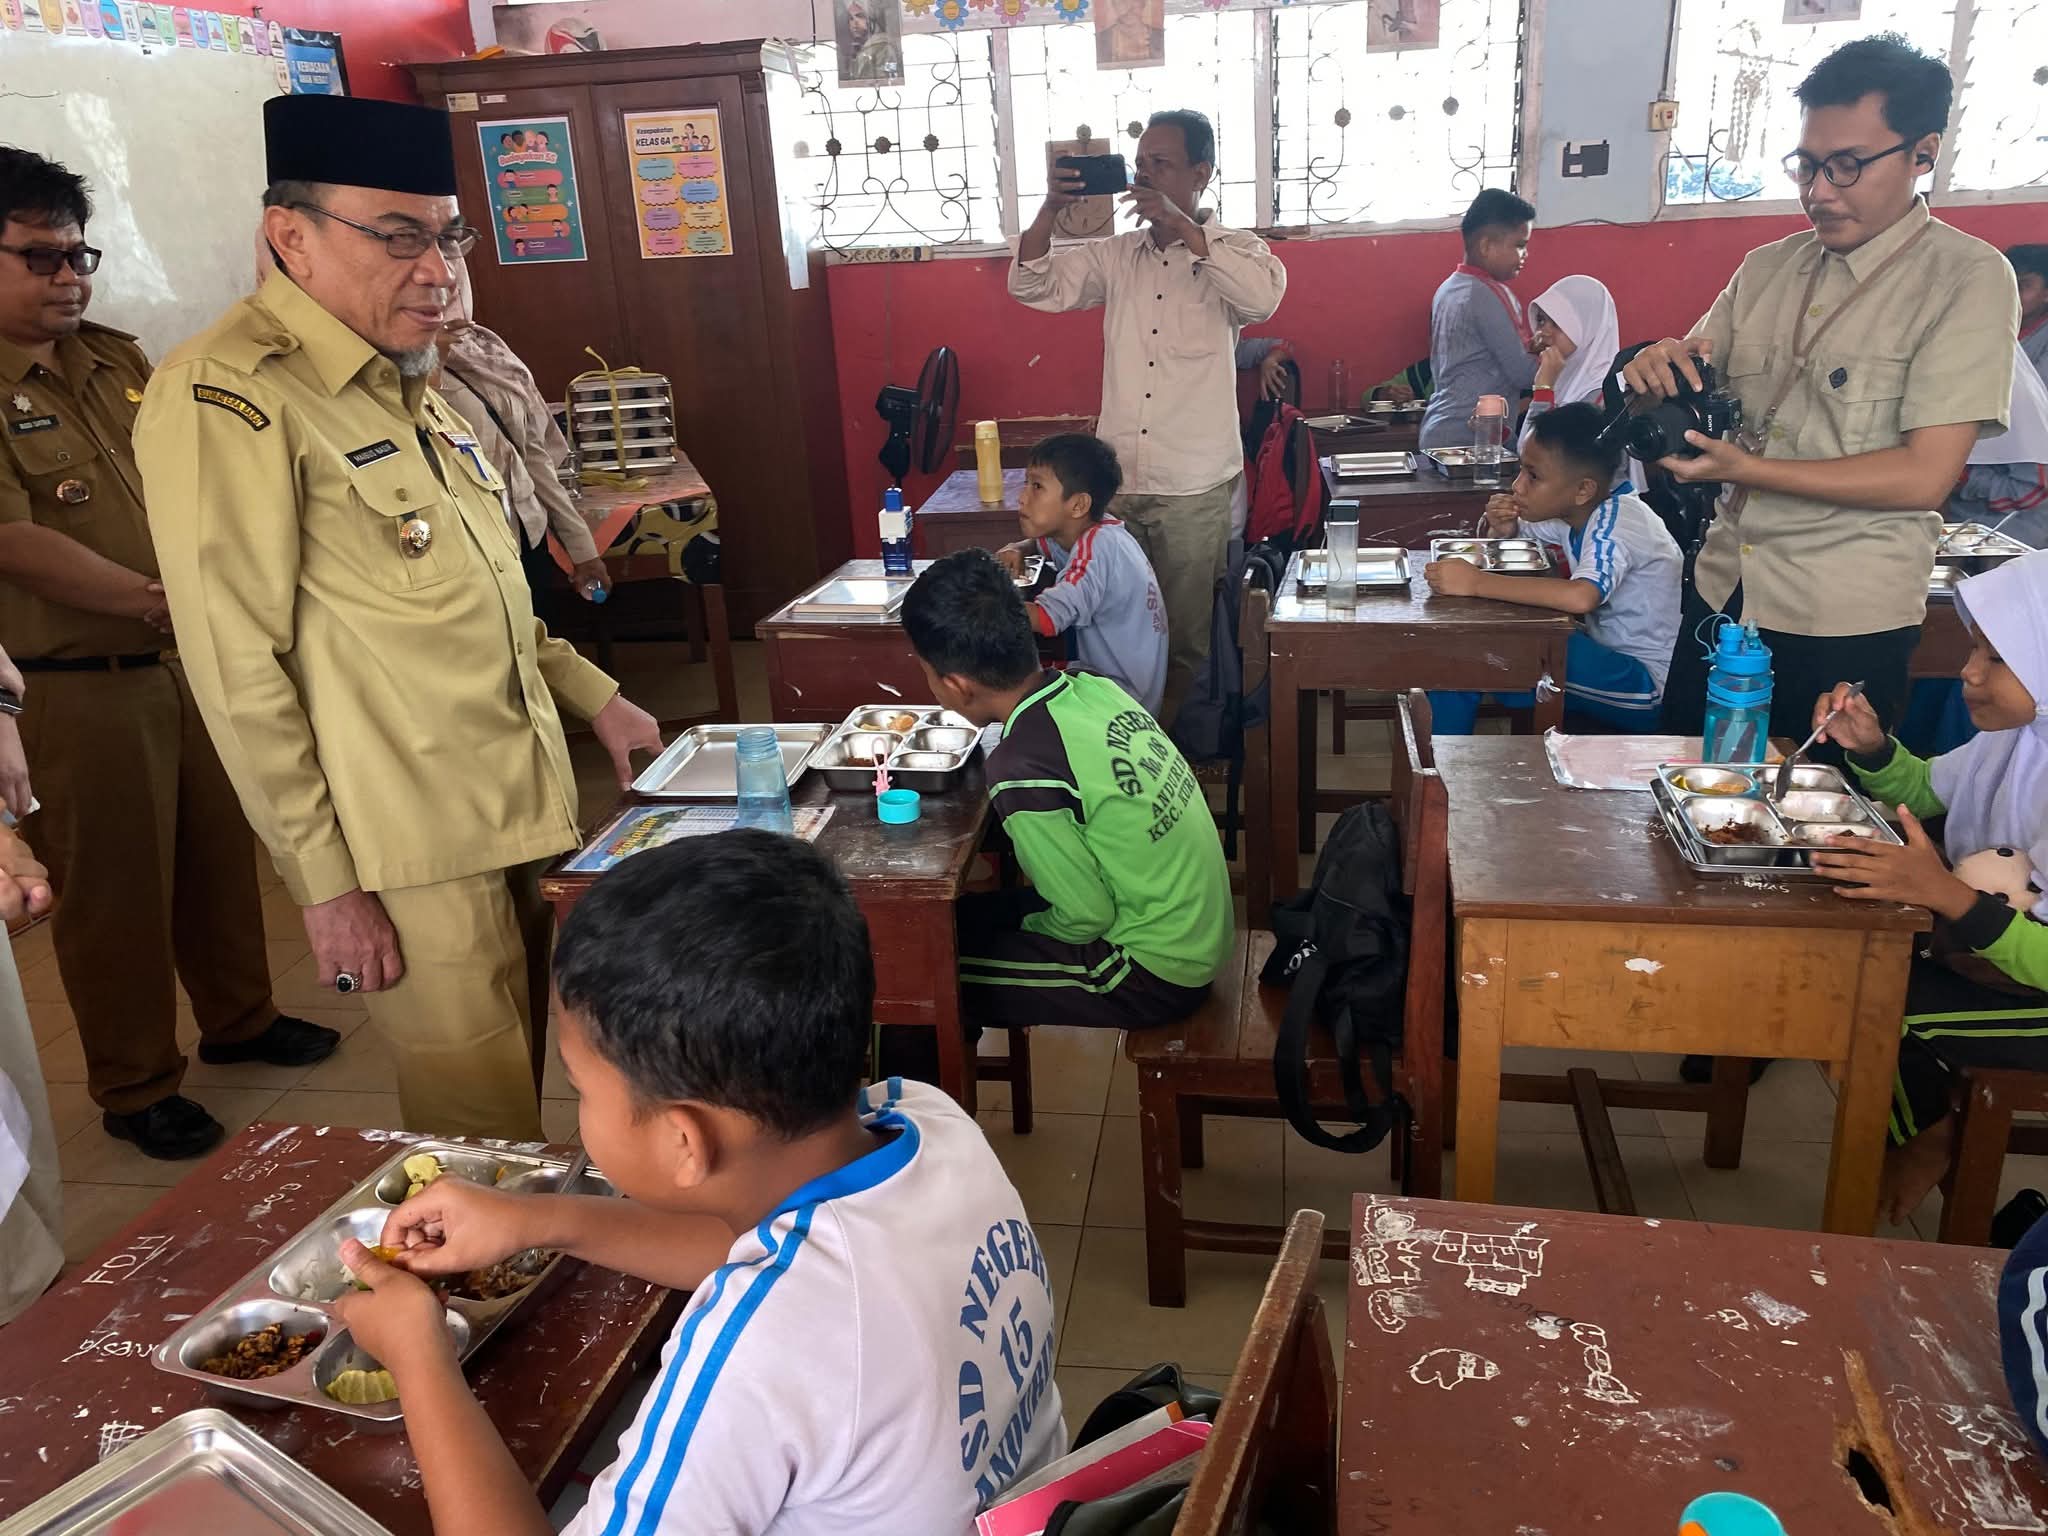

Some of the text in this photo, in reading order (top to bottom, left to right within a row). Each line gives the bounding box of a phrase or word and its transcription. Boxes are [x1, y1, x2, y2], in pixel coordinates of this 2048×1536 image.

[636, 137, 671, 147] KELAS 6A
[1107, 710, 1168, 798] SD NEGER
[1146, 769, 1197, 843] KEC. KURA
[1000, 1296, 1033, 1394] 15
[958, 1361, 989, 1472] SD
